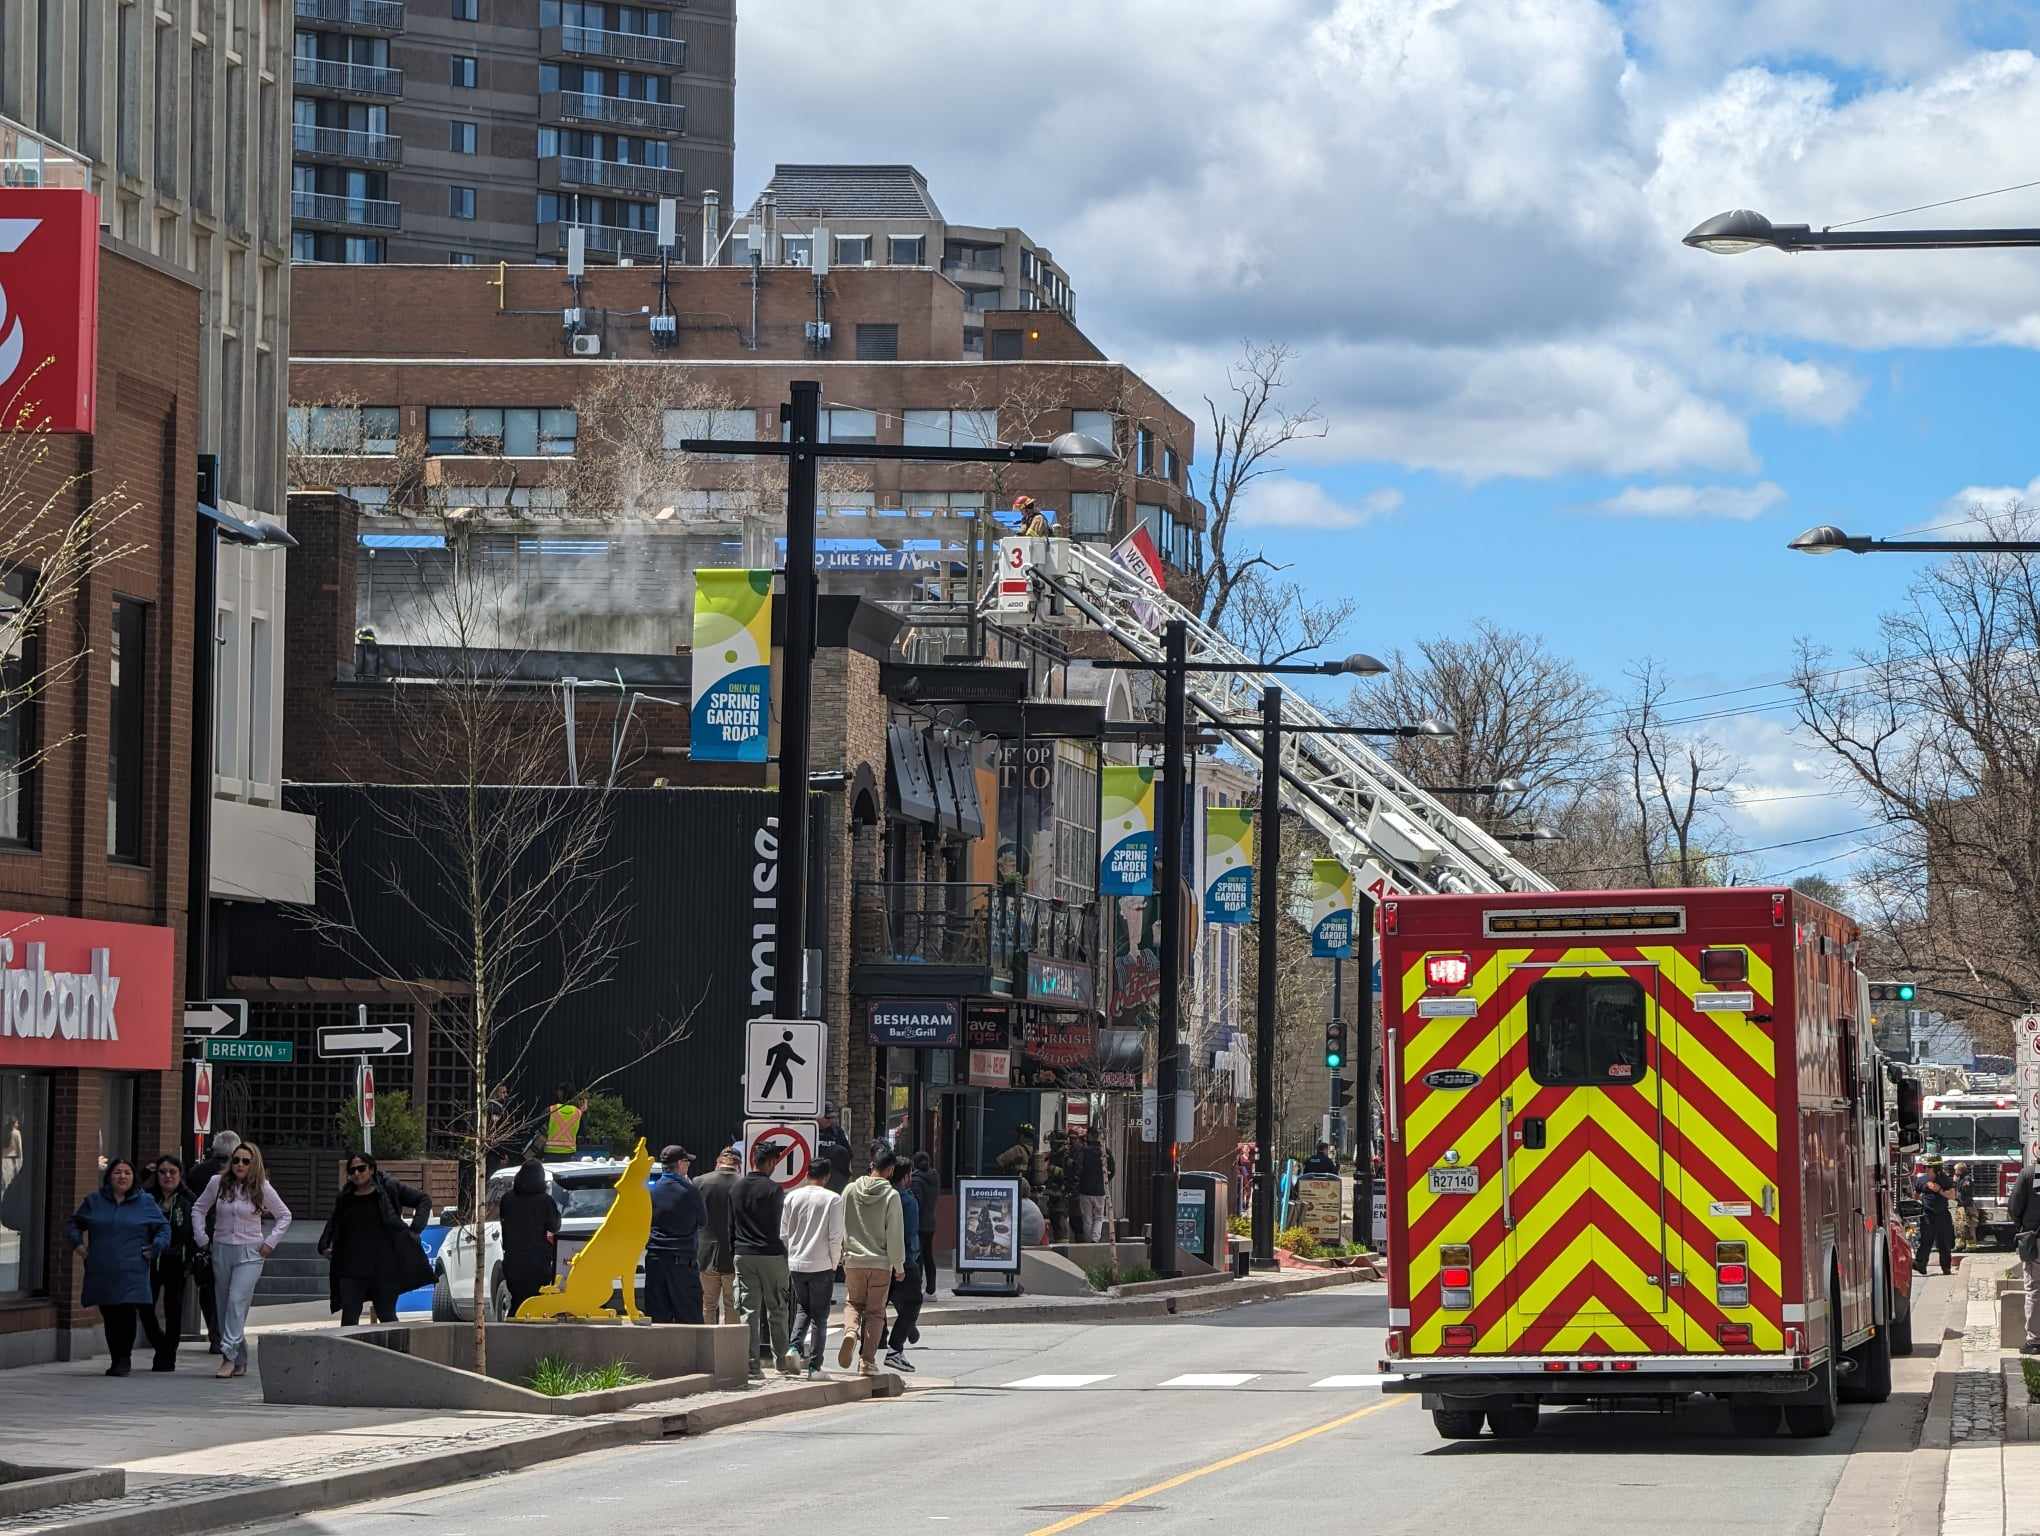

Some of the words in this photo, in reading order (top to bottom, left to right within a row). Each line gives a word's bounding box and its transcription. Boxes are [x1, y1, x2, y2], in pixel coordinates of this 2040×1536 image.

[829, 553, 860, 567] LIKE
[1011, 548, 1023, 568] 3
[728, 683, 747, 693] ONLY
[749, 684, 761, 693] ON
[710, 693, 760, 710] SPRING
[706, 709, 759, 726] GARDEN
[722, 725, 759, 742] ROAD
[1113, 849, 1147, 862] SPRING
[1111, 861, 1147, 872] GARDEN
[1121, 872, 1147, 883] ROAD
[1217, 882, 1247, 892] SPRING
[1215, 891, 1247, 902] GARDEN
[1224, 901, 1247, 911] ROAD
[1321, 923, 1347, 931] SPRING
[1320, 931, 1347, 940] GARDEN
[0, 937, 121, 1041] iabank
[873, 1014, 953, 1025] BESHARAM
[889, 1027, 905, 1037] Bar
[915, 1027, 937, 1037] Grill
[212, 1043, 273, 1058] BRENTON
[277, 1048, 287, 1056] ST
[1429, 1075, 1474, 1084] E-ONE
[1433, 1175, 1474, 1188] R27140
[971, 1189, 1007, 1197] Leonidas
